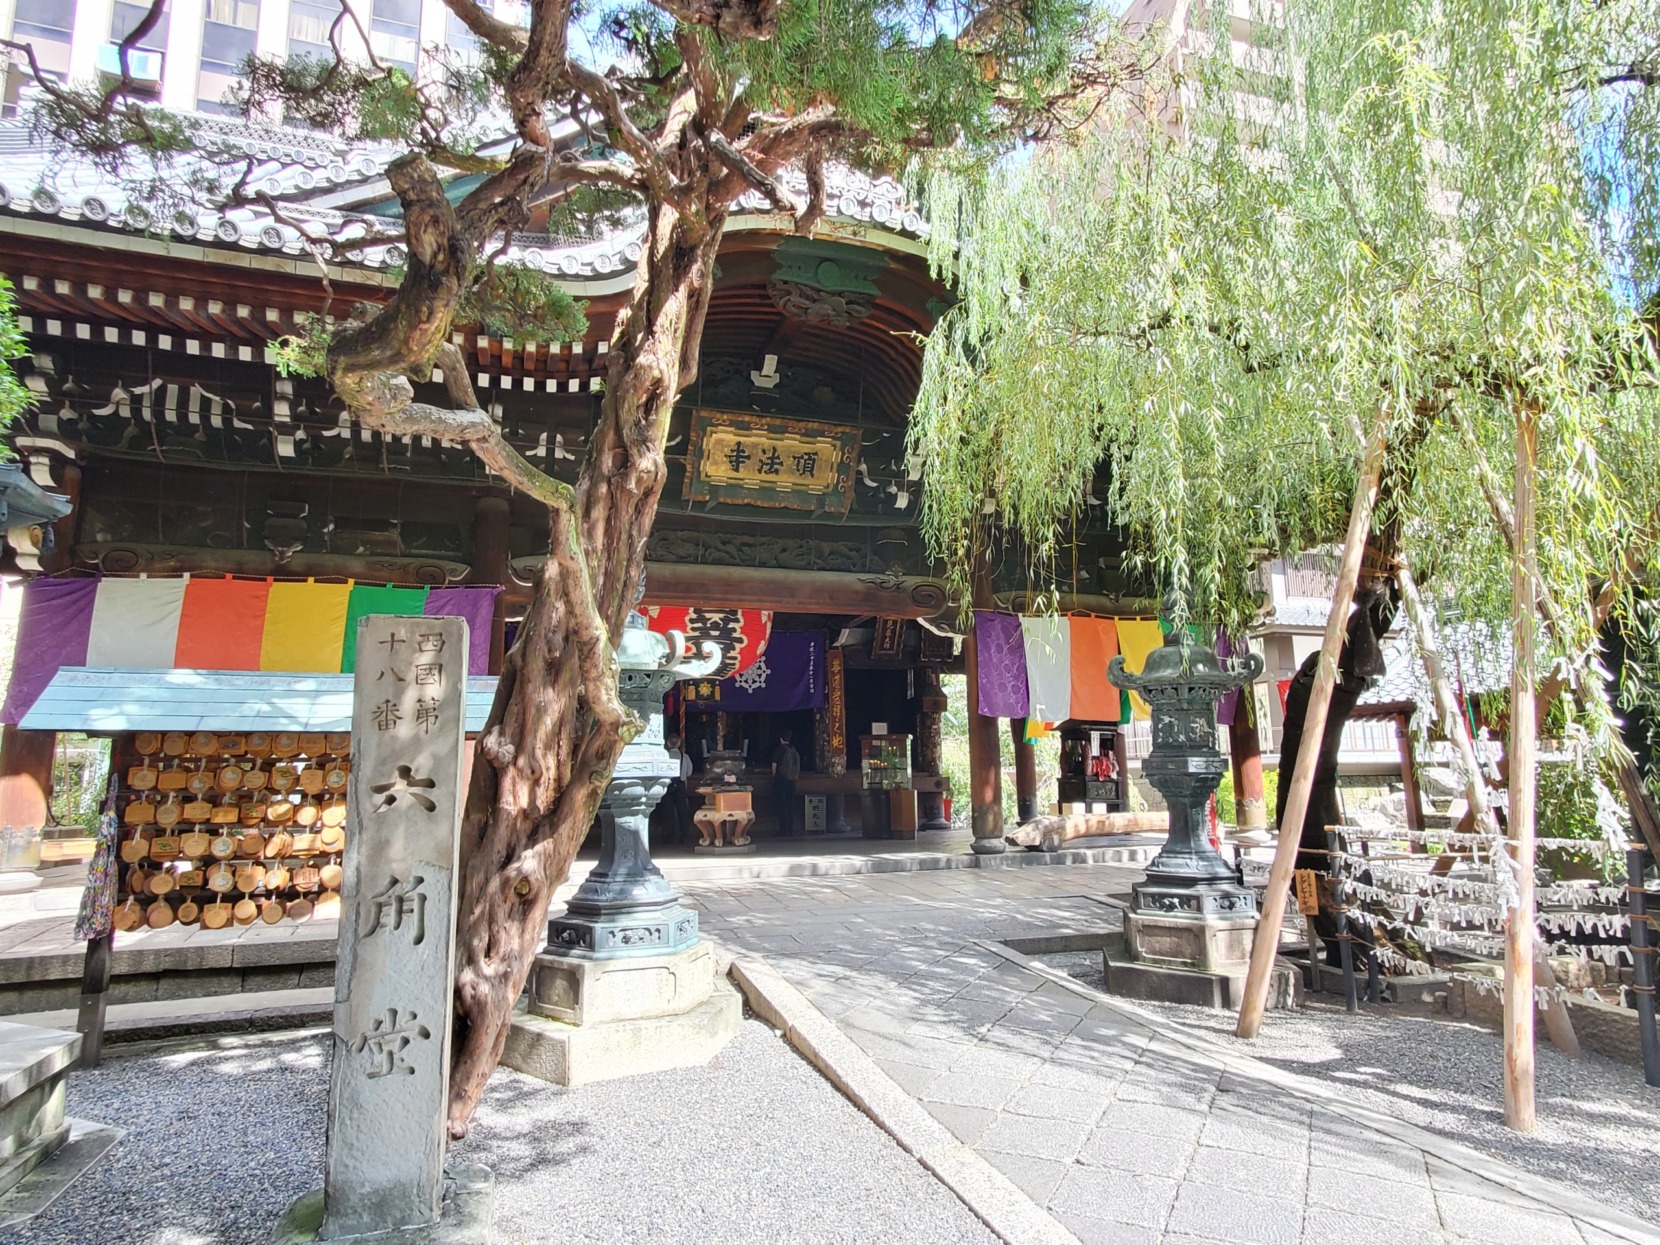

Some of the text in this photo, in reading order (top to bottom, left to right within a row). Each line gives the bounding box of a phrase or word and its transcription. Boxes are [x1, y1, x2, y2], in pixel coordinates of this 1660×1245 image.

[724, 440, 819, 478] 頂法寺
[371, 631, 407, 732] 十八番
[414, 631, 446, 735] 西國第
[351, 764, 437, 1080] 六角堂
